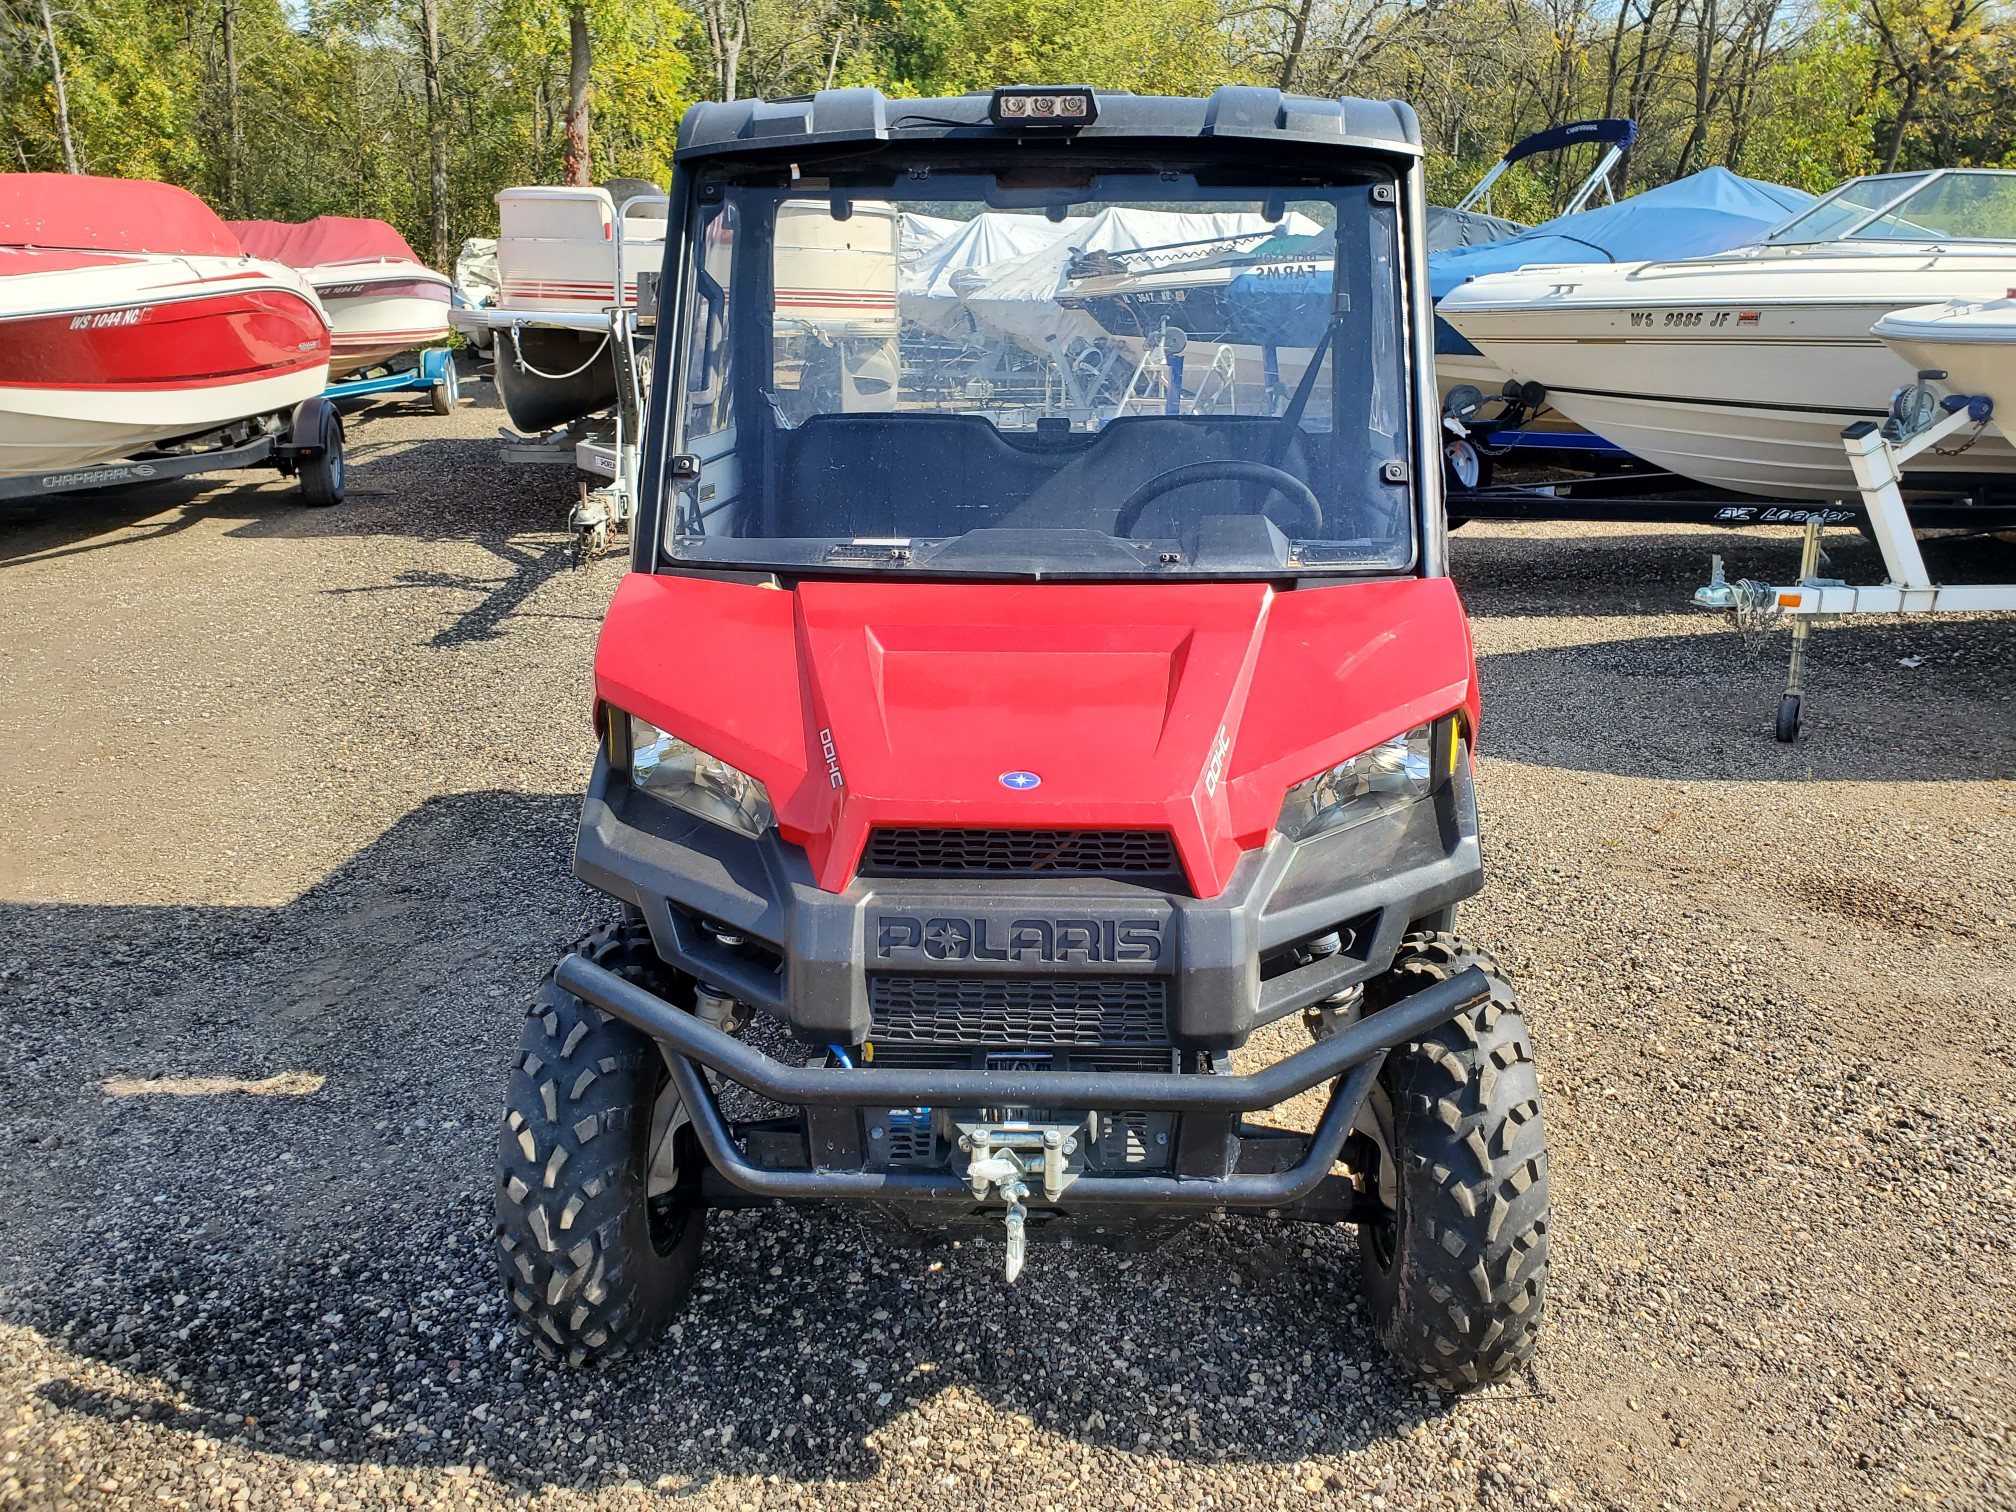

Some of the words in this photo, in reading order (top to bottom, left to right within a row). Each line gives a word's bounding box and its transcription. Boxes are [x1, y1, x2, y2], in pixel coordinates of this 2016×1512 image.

[69, 315, 92, 330] WS
[92, 311, 122, 328] 1044
[122, 308, 139, 326] NC
[1631, 312, 1653, 327] WS
[1664, 312, 1703, 327] 9885
[1710, 312, 1730, 327] JF
[42, 467, 132, 488] CHAPARRAL
[1714, 507, 1758, 521] EZ
[1760, 507, 1856, 522] Loader
[818, 728, 844, 790] DOHC
[1204, 724, 1230, 798] DOHC
[876, 916, 1162, 963] POLARIS
